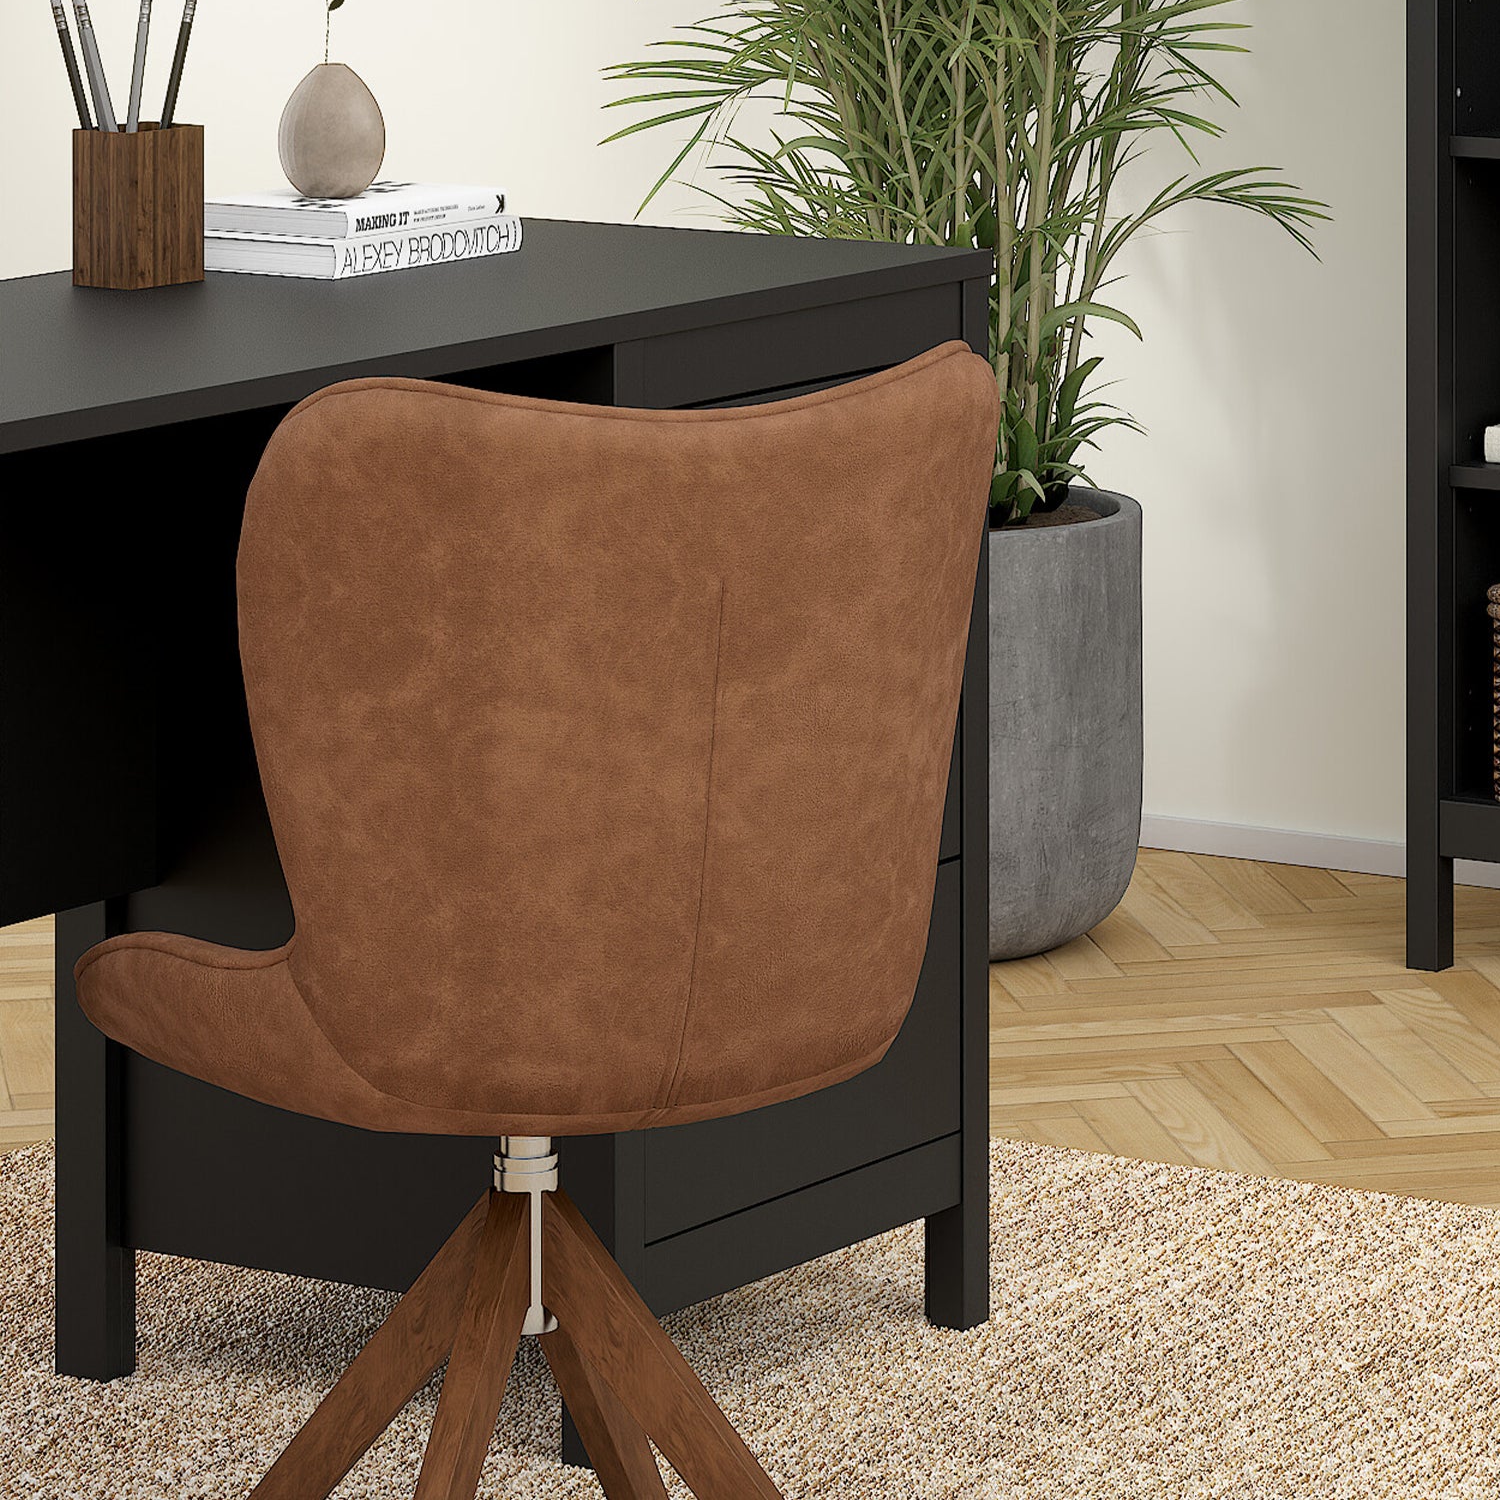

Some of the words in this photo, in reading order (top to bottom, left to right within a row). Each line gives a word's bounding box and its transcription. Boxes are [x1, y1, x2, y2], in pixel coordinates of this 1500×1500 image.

[355, 213, 397, 233] MAKING
[399, 211, 409, 225] IT
[341, 239, 403, 275] ALEXEY
[408, 223, 509, 265] BRODOVITCH
